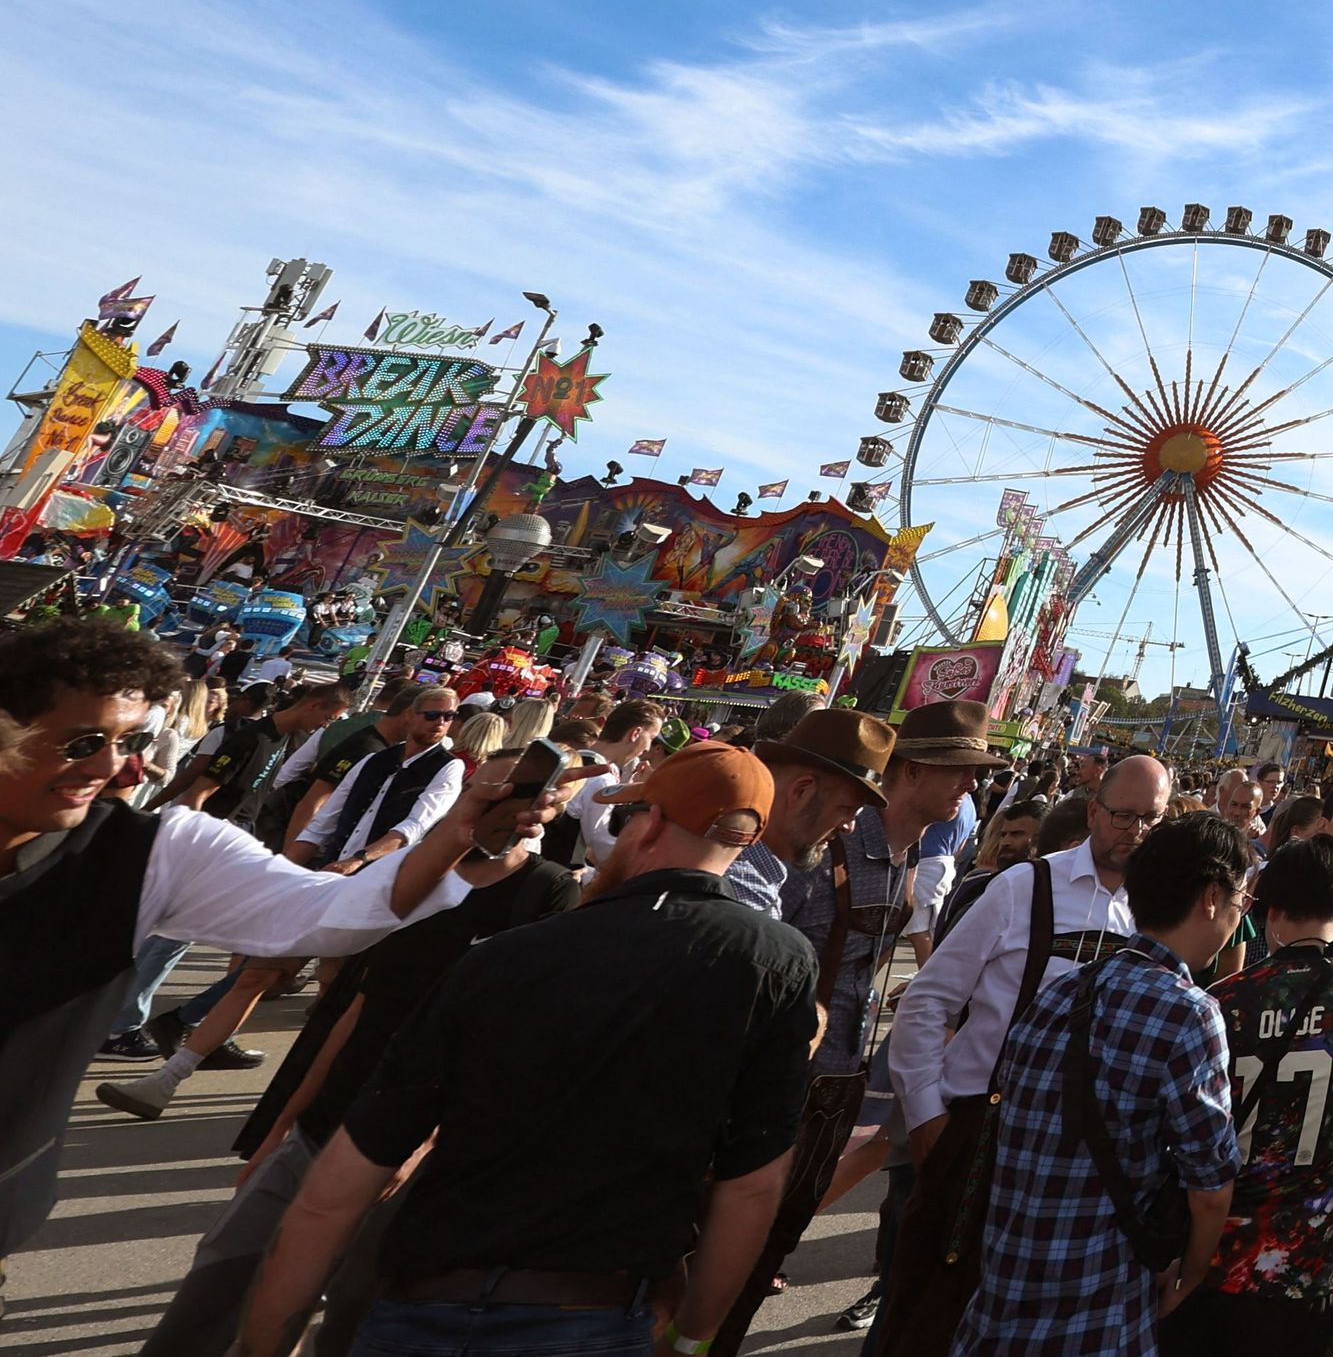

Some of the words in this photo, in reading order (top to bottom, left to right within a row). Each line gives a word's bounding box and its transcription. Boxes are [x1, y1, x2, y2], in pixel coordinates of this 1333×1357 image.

[297, 349, 486, 404] BREAK
[318, 403, 502, 453] DANCE
[773, 672, 818, 692] KASSE
[1268, 692, 1328, 722] Filzherzen
